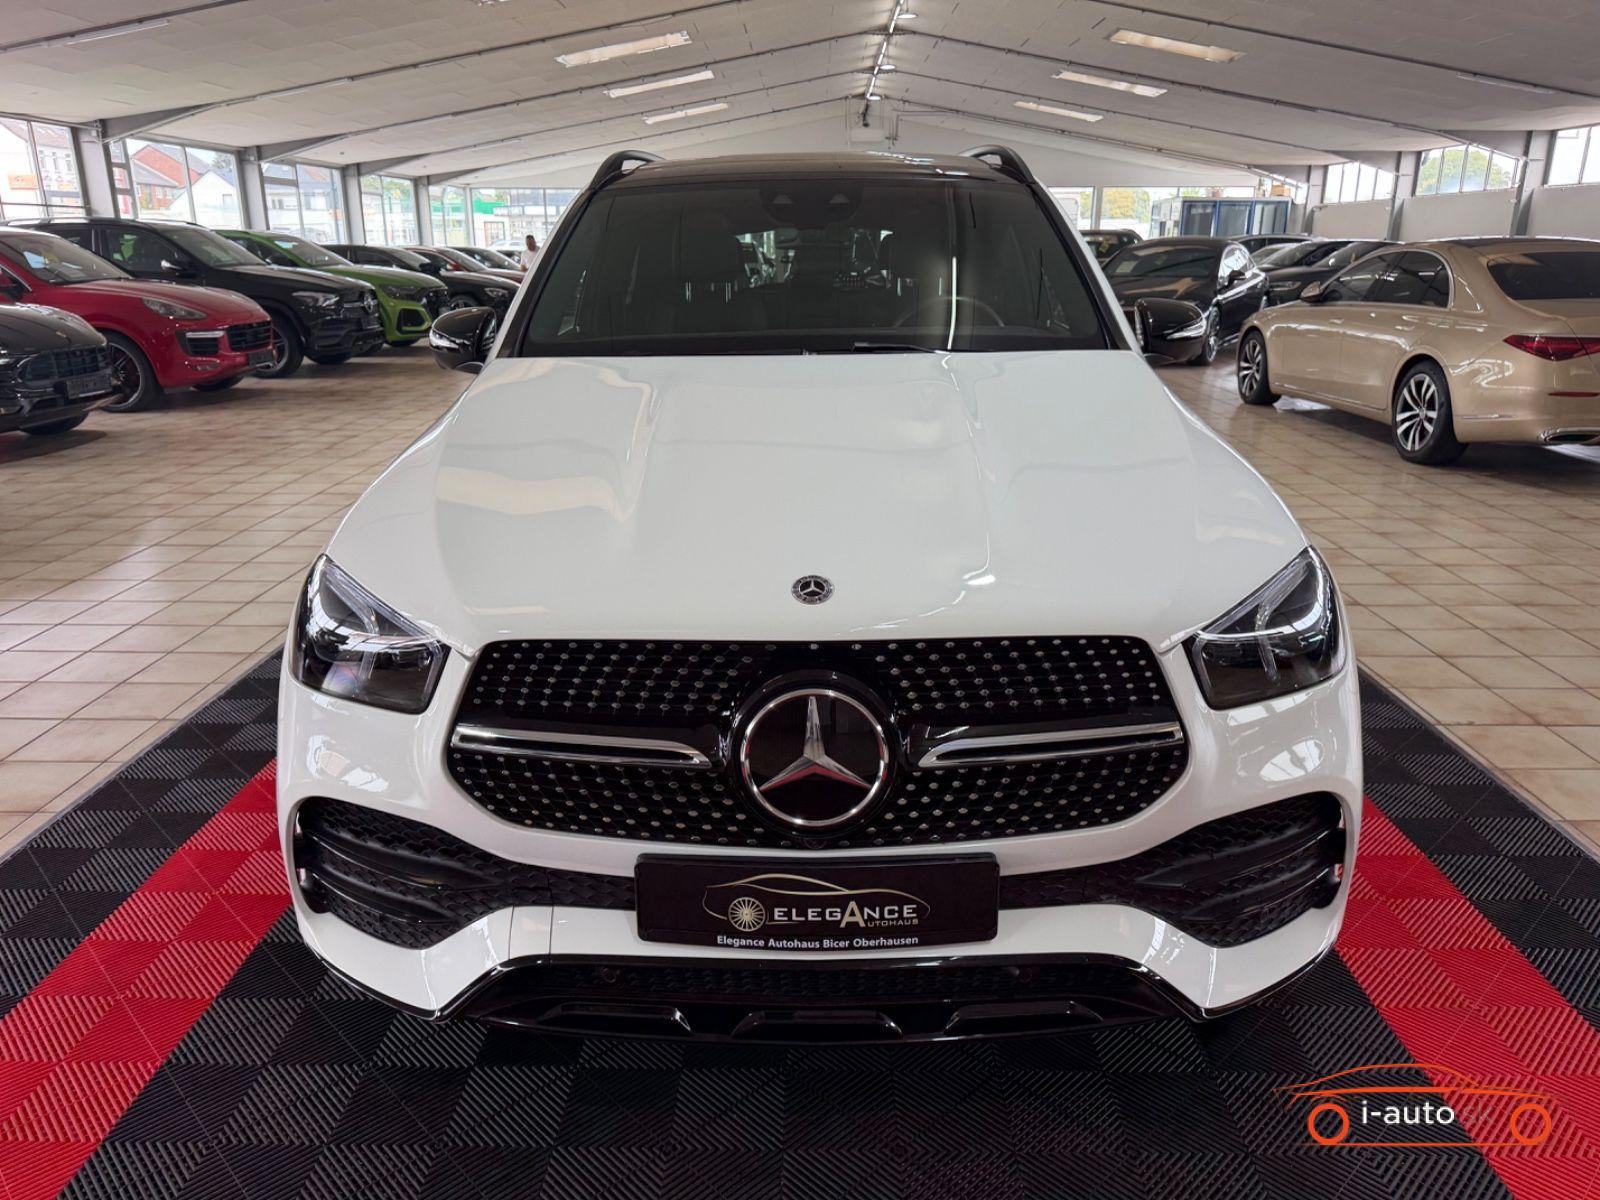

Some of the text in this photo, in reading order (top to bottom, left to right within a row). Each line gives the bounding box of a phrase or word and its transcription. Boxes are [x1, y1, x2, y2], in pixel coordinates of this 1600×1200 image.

[773, 900, 918, 928] ELEGANCE
[716, 935, 919, 949] Elegance Autohaus Bicer Oberhausen
